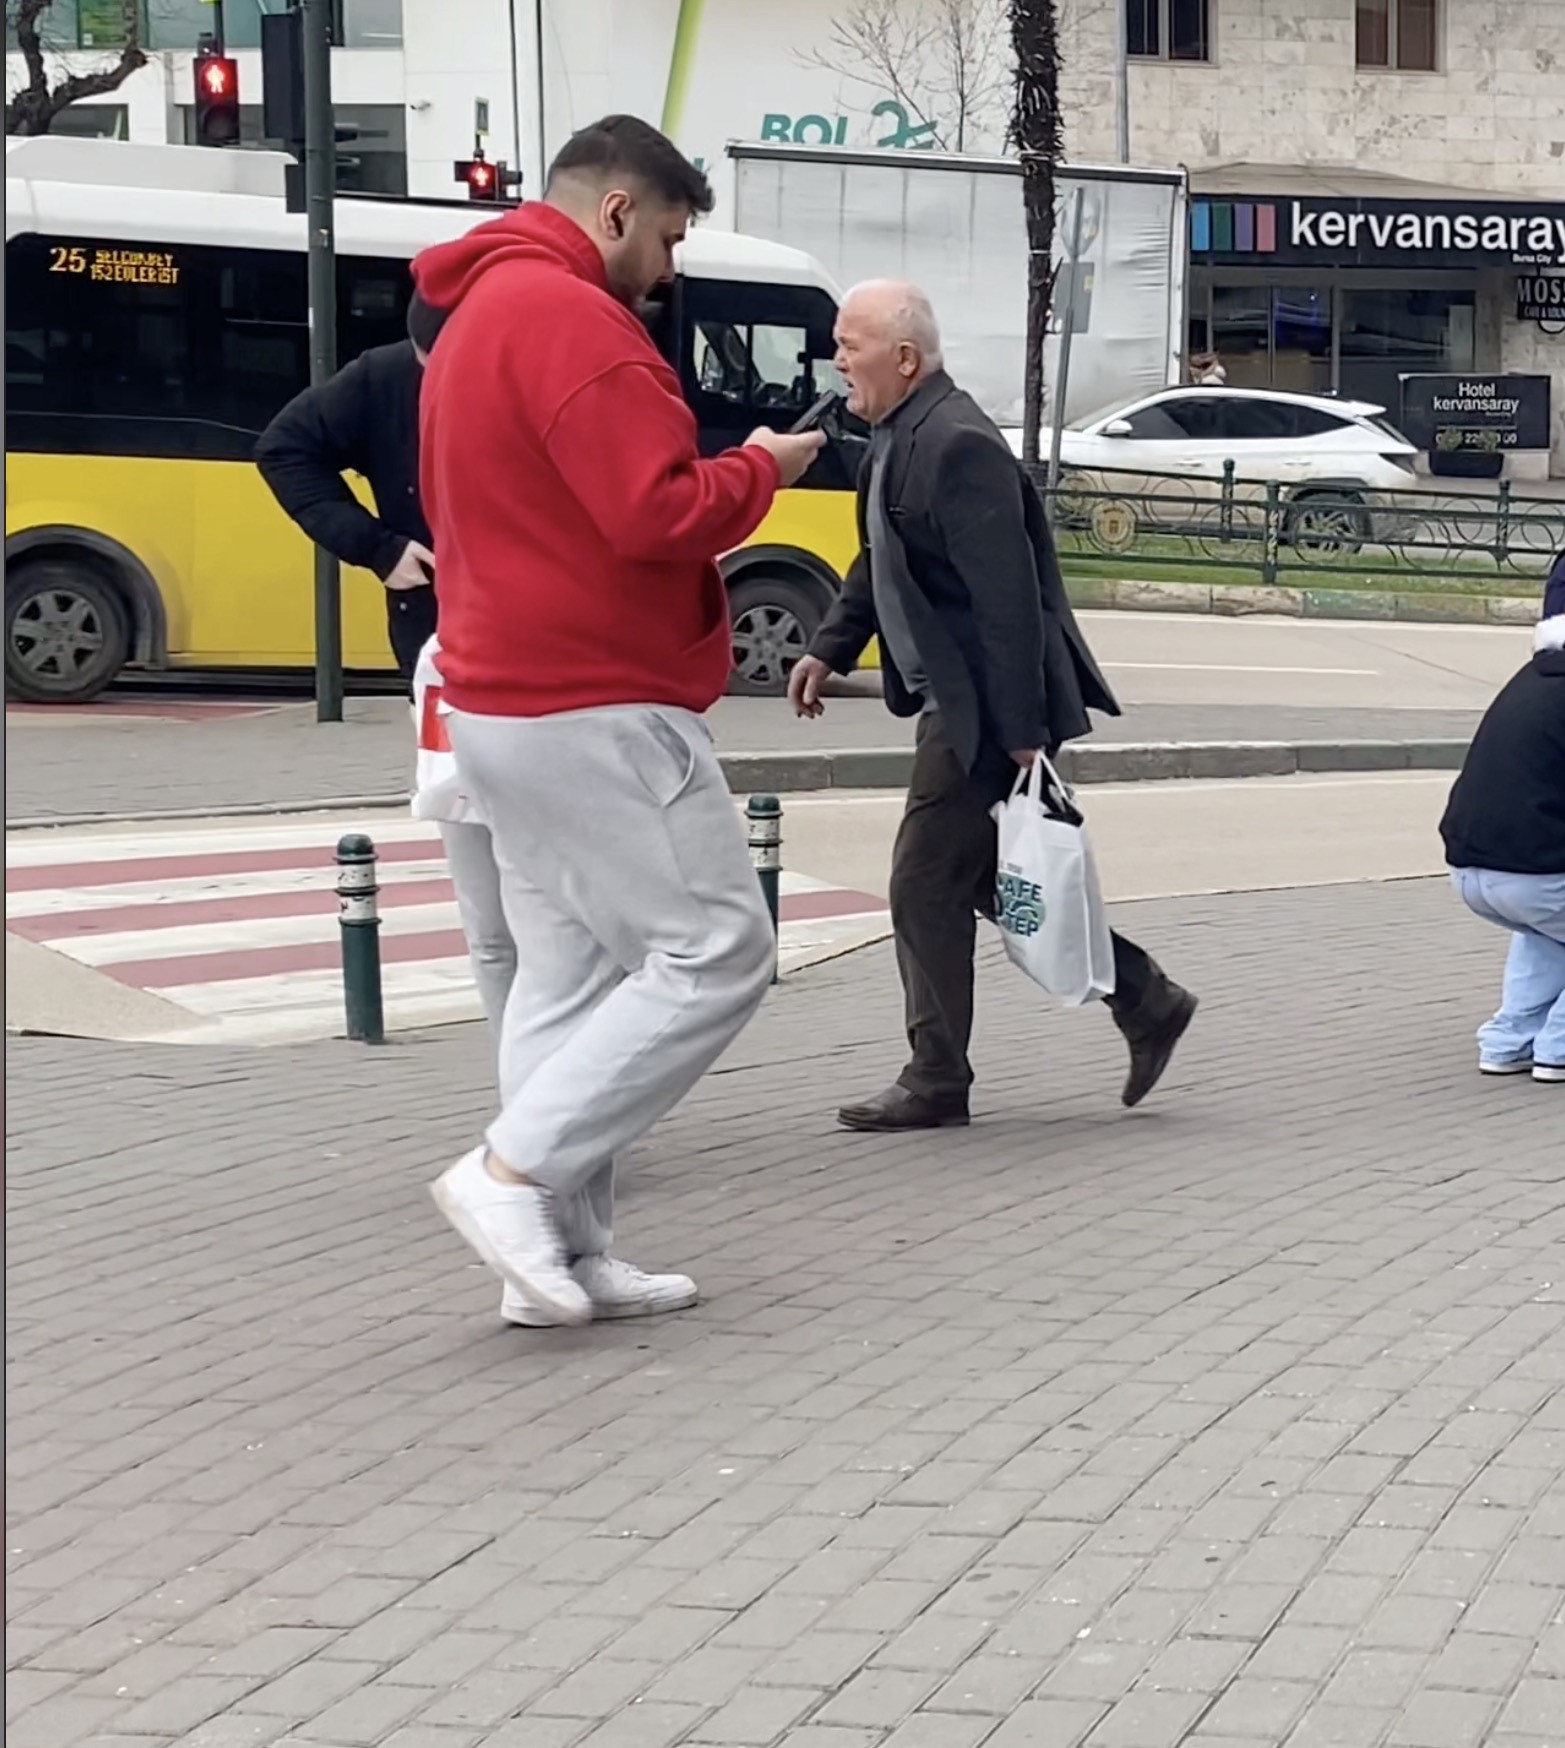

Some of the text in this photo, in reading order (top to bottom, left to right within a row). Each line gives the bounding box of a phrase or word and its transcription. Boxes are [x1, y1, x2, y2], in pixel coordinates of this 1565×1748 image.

[49, 247, 87, 273] 25
[1459, 383, 1496, 397] Hotel
[1433, 396, 1519, 414] kervansaray
[998, 876, 1042, 903] AFE
